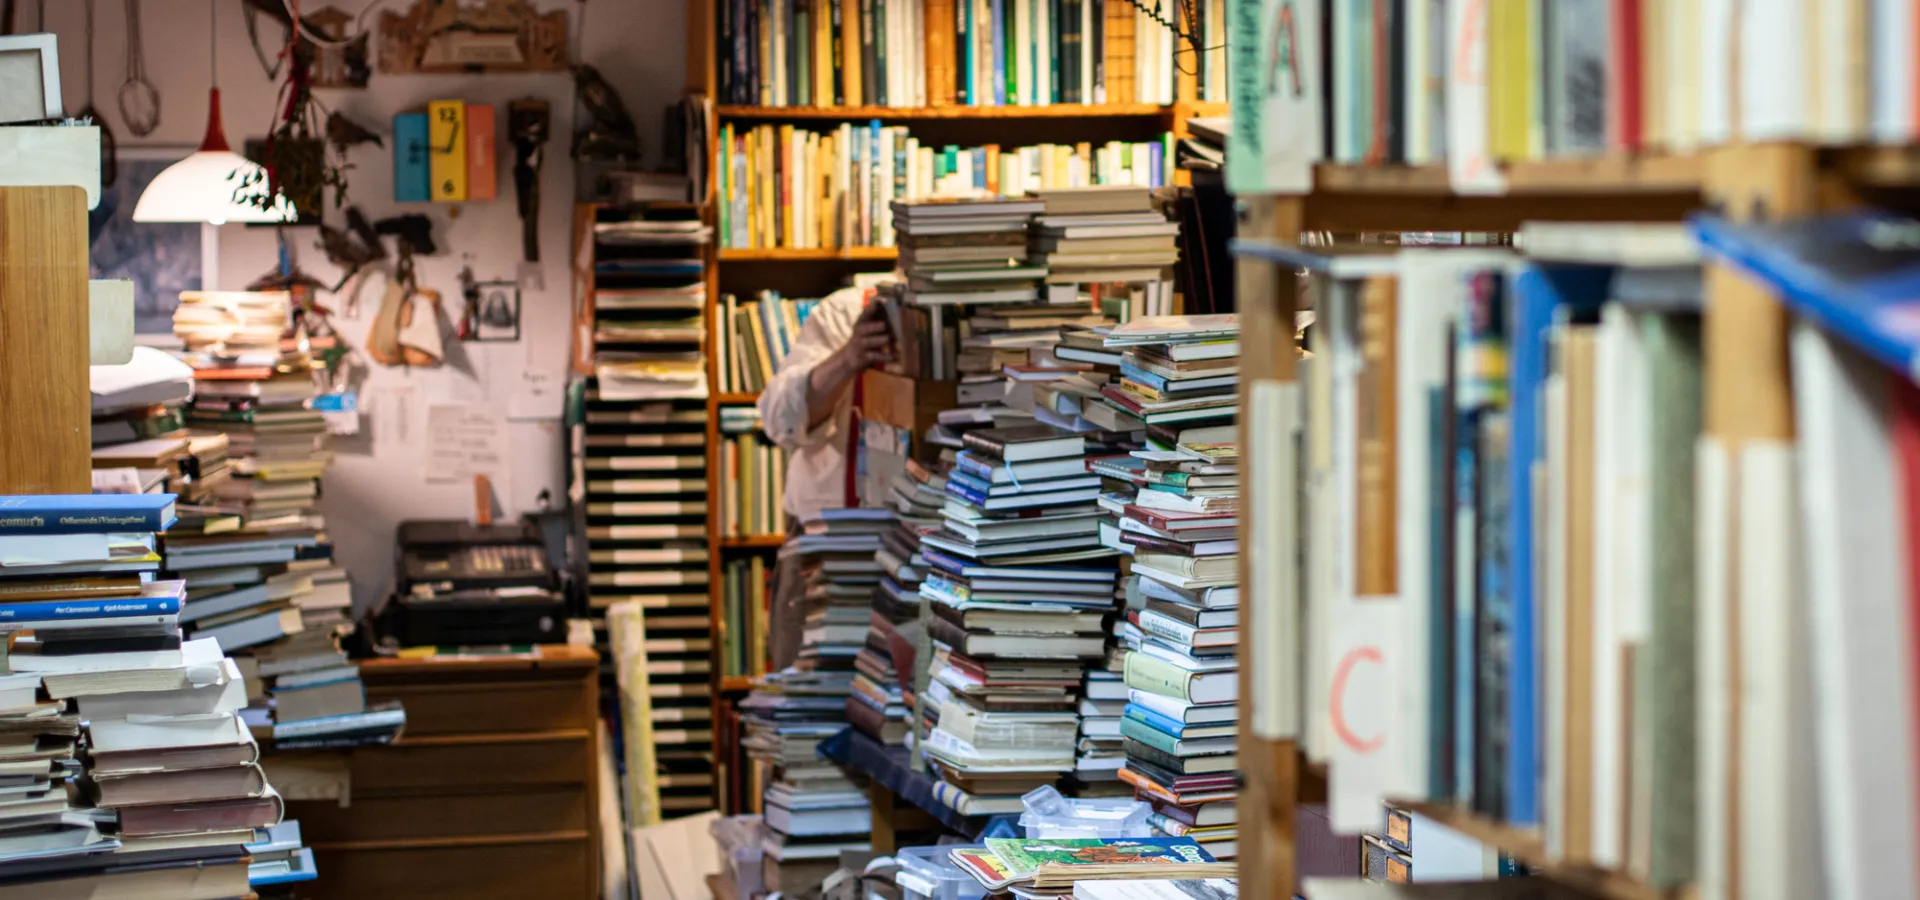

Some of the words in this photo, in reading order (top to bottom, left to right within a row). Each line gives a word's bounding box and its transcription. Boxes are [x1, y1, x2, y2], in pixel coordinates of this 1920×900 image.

[1266, 2, 1304, 98] A
[439, 107, 457, 123] 12
[443, 179, 455, 195] 6
[1330, 646, 1384, 753] C
